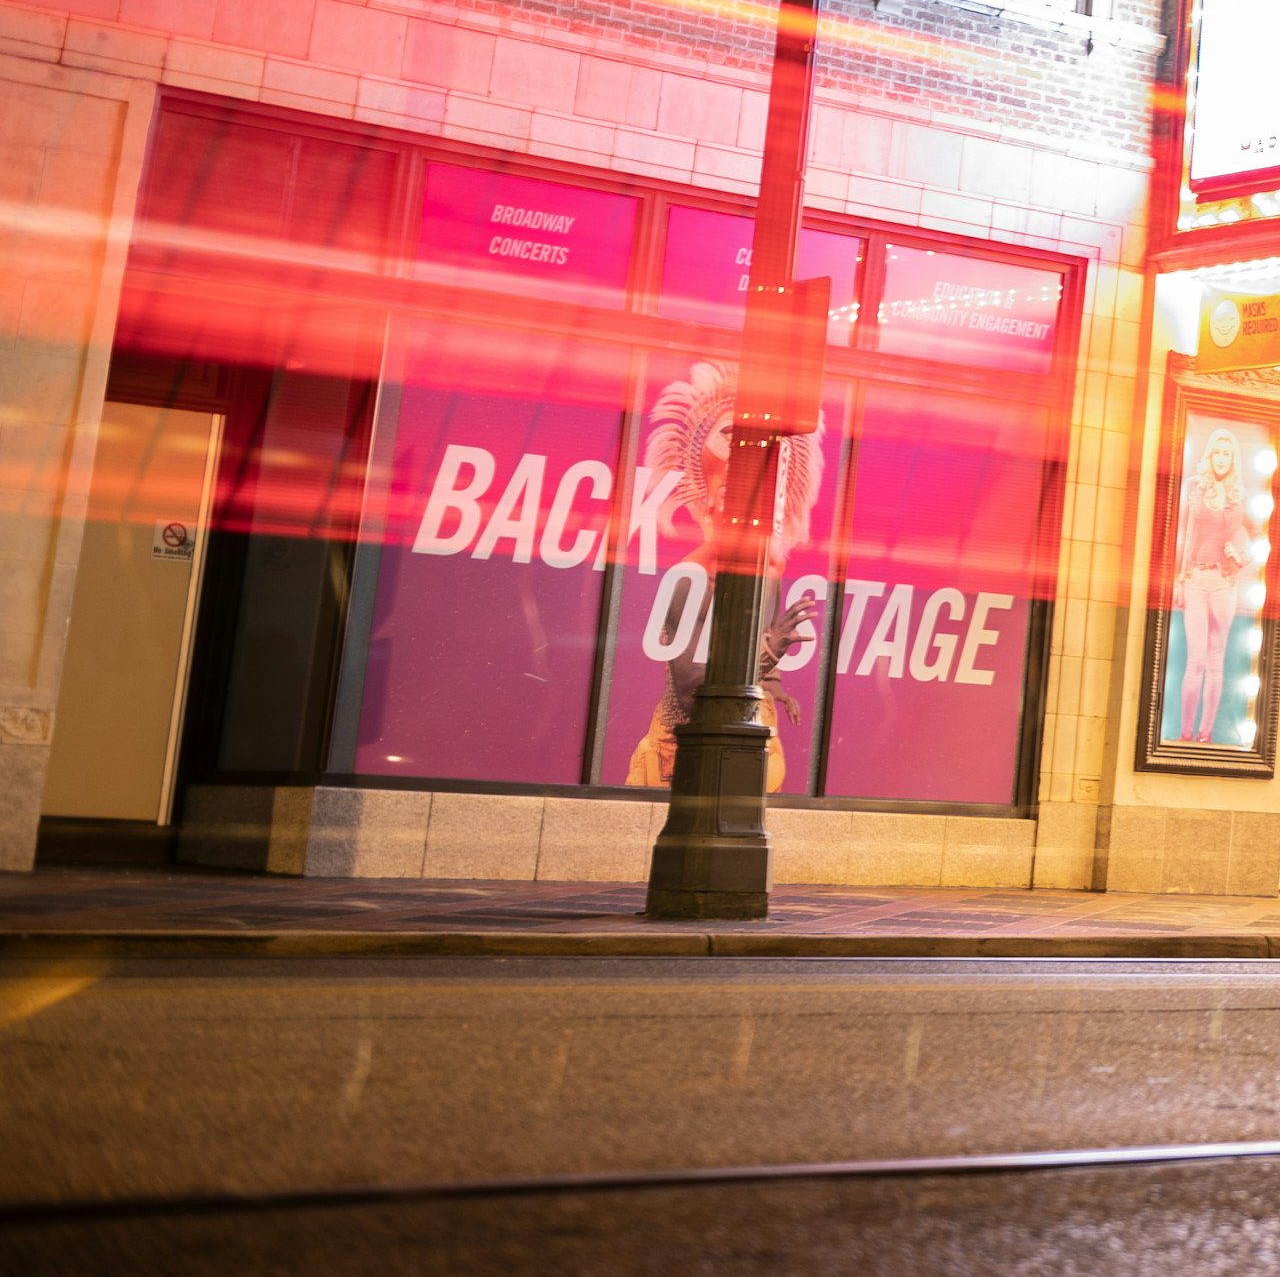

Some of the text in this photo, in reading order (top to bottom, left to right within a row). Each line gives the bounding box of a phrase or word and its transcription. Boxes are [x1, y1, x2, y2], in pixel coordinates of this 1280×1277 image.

[490, 204, 575, 234] BROADWAY
[488, 236, 570, 265] CONCERTS
[933, 281, 1002, 307] EDUCATION
[891, 300, 1051, 340] COMMUNITY ENGAGEMENT
[1242, 301, 1267, 319] MASKS
[1242, 318, 1278, 336] REQUIRED
[411, 444, 687, 575] BACK
[775, 574, 1014, 686] STAGE
